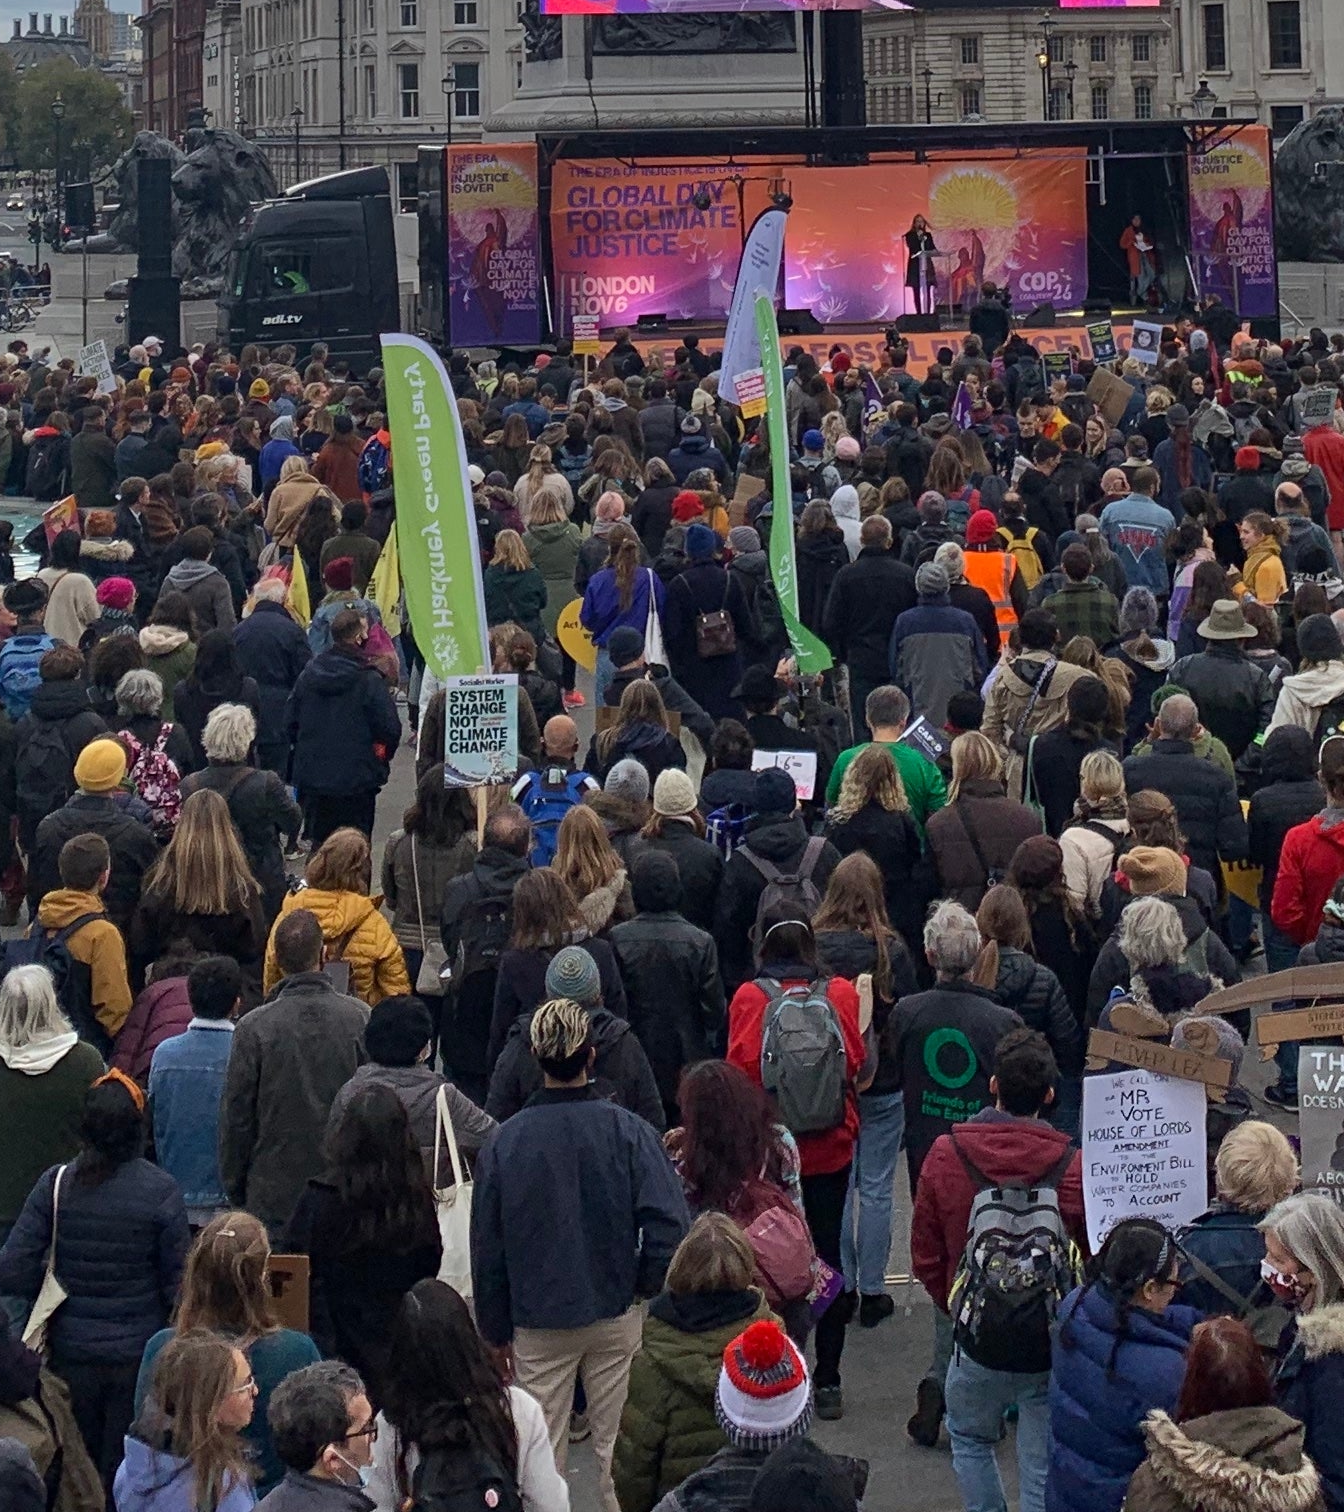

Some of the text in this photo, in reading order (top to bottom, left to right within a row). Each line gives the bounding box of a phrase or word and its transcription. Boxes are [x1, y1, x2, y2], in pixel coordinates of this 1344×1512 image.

[452, 153, 498, 164] THE ERA
[452, 164, 465, 173] OF
[1201, 165, 1229, 174] OVER
[451, 173, 509, 184] INJUSTICE
[451, 184, 494, 194] IS OVER
[567, 185, 672, 208] GLOBAL
[566, 206, 737, 233] FOR CLIMATE
[1228, 226, 1269, 236] GLOBAL
[568, 234, 679, 258] JUSTICE
[1227, 236, 1270, 246] DAY FOR
[490, 250, 535, 260] GLOBAL
[1226, 246, 1273, 255] CLIMATE
[489, 259, 536, 270] DAY FOR
[1242, 264, 1265, 274] NOV
[487, 270, 536, 280] CLIMATE
[489, 279, 536, 290] JUSTICE
[570, 275, 655, 297] LONDON
[1019, 271, 1072, 300] COP 26
[503, 289, 536, 299] NOV 6
[616, 298, 628, 313] 6
[262, 315, 303, 325] adi.tv
[563, 621, 578, 629] Act
[449, 689, 504, 703] SYSTEM
[449, 702, 507, 716] CHANGE
[449, 715, 479, 728] NOT
[449, 727, 508, 741] CLIMATE
[449, 740, 507, 754] CHANGE
[1112, 1040, 1202, 1076] RIVER LEA
[1111, 1078, 1126, 1089] WE
[1130, 1075, 1151, 1086] CALL
[967, 1099, 981, 1111] of
[1120, 1090, 1150, 1107] MPs
[921, 1104, 968, 1121] the Ear
[1121, 1106, 1165, 1121] VOTE
[1088, 1121, 1192, 1141] HOUSE OF LORDS
[1112, 1139, 1170, 1152] AMENDMENT
[1090, 1156, 1195, 1177] ENVIRONMENT BILL
[1125, 1172, 1159, 1184] HOLD
[1091, 1179, 1188, 1198] WATER COMPANIES
[1103, 1192, 1181, 1208] TO ACCOUNT
